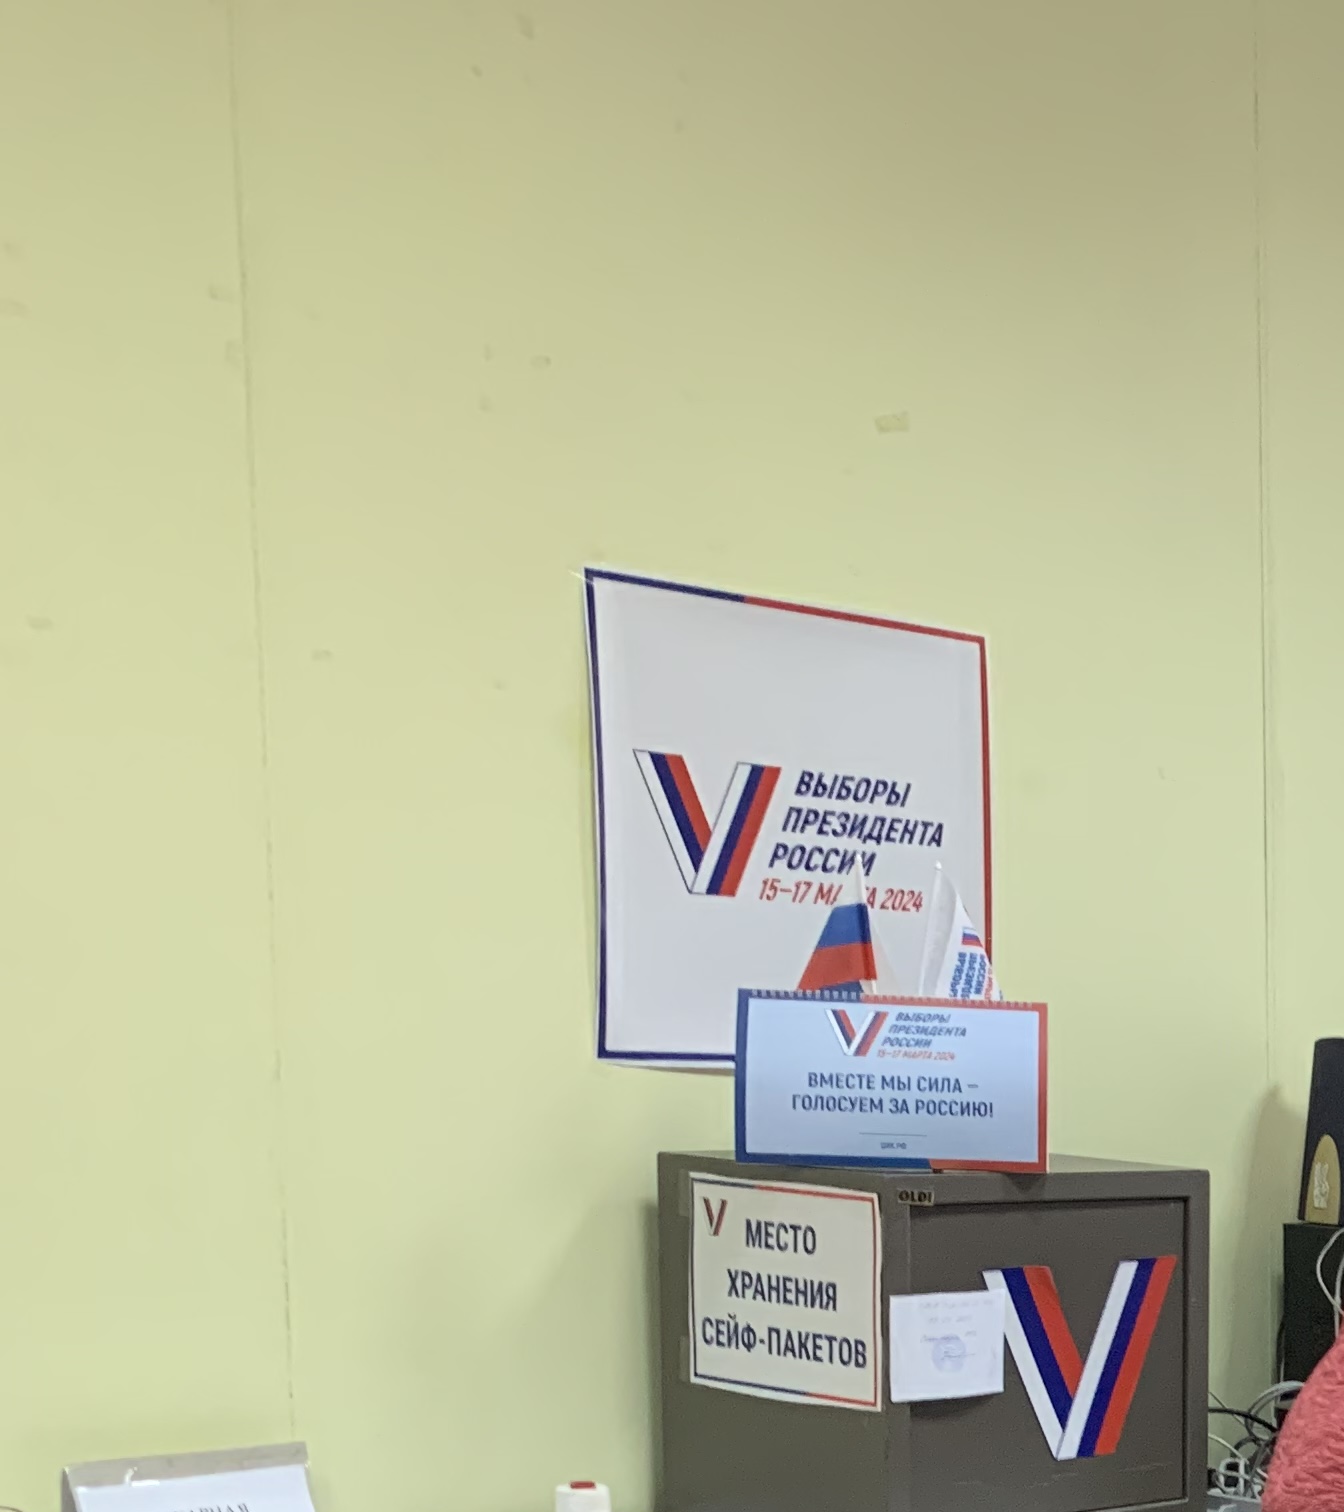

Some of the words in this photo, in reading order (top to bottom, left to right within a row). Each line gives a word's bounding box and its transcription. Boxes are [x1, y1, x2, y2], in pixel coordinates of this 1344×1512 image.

[794, 770, 912, 807] ВЫБОРЫ
[782, 806, 944, 847] ПРЕЗИДЕНТА
[768, 842, 877, 876] РОССИИ
[879, 888, 923, 912] 2024
[895, 1012, 951, 1024] ВЫБОРЫ
[881, 1036, 932, 1048] РОССИИ
[888, 1024, 967, 1037] ПРЕЗИДЕНТА
[902, 1050, 932, 1060] МАРТА
[934, 1051, 956, 1061] 2024
[807, 1072, 875, 1091] ВМЕСТЕ
[881, 1075, 911, 1091] МЫ
[917, 1076, 963, 1093] СИЛА
[791, 1094, 883, 1114] ГОЛОСУЕМ
[889, 1098, 910, 1115] ЗА
[915, 1100, 994, 1118] РОССИЮ!
[745, 1218, 817, 1255] МЕСТО
[727, 1268, 838, 1312] ХРАНЕНИЯ
[702, 1312, 868, 1369] СЕЙФ-ПАКЕТОВ
